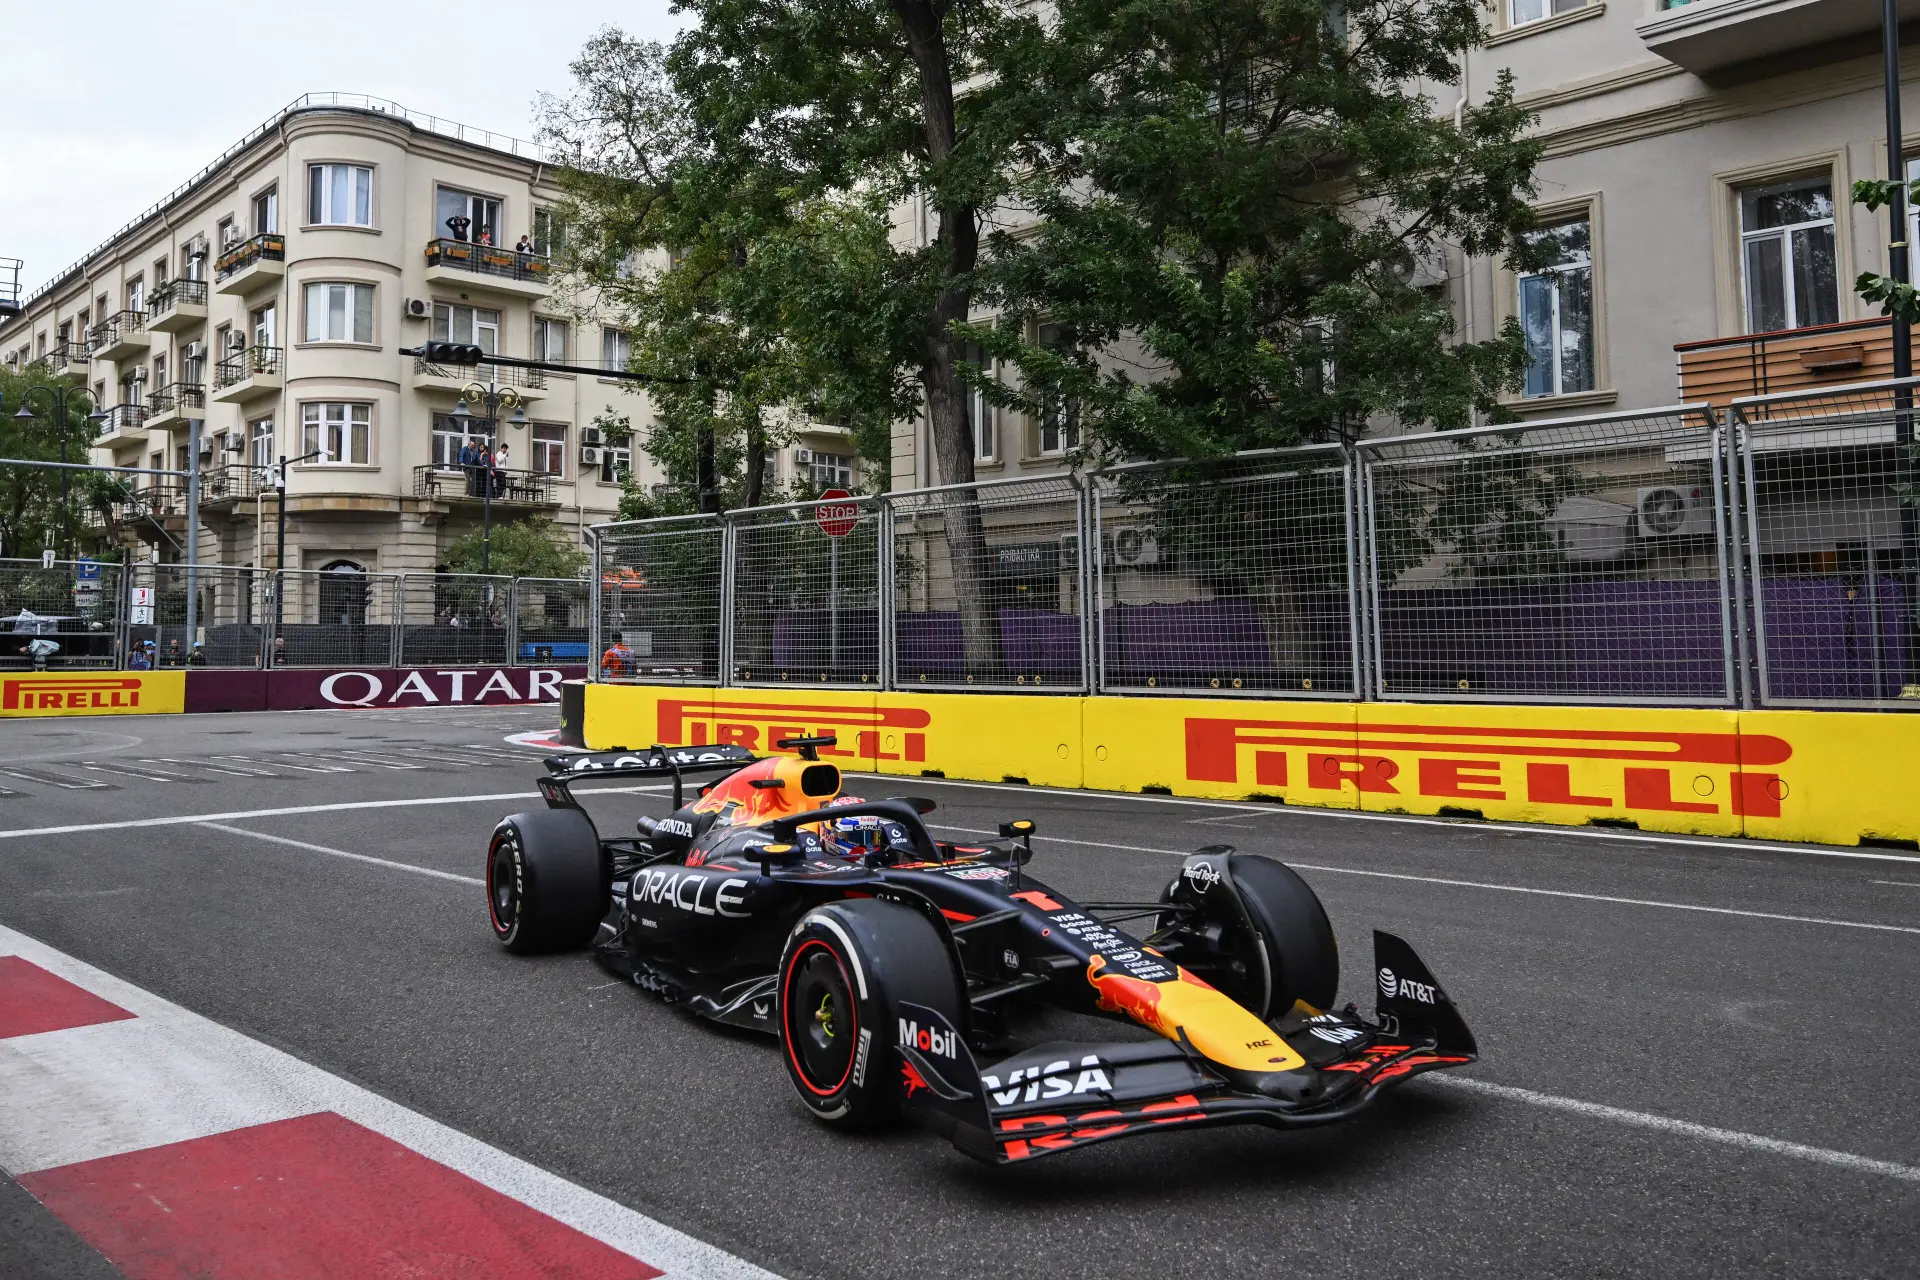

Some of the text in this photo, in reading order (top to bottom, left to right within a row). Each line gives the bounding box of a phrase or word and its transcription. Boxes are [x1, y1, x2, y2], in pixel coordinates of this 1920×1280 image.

[819, 505, 855, 519] STOP
[1000, 547, 1040, 562] PRIBALTIKA
[3, 679, 142, 710] PIRELLI
[320, 670, 562, 707] QATAR
[657, 699, 931, 762] PIRELLI
[1184, 717, 1793, 818] PIRELLI
[656, 818, 693, 838] HONDA
[890, 837, 908, 845] Gate
[505, 829, 523, 894] P ZERO
[1183, 866, 1203, 880] Hard
[632, 869, 752, 918] ORACLE
[1008, 890, 1065, 912] 1
[1048, 913, 1086, 922] VISA
[1080, 925, 1104, 933] AT&T
[1004, 952, 1018, 966] FIA
[1101, 946, 1136, 955] CARLYLE
[1138, 972, 1166, 980] Mobil
[1399, 978, 1436, 1005] AT&T
[899, 1017, 957, 1060] Mobil
[1245, 1039, 1273, 1050] HRC
[853, 1027, 872, 1088] PIRELLI
[981, 1054, 1113, 1106] VISA
